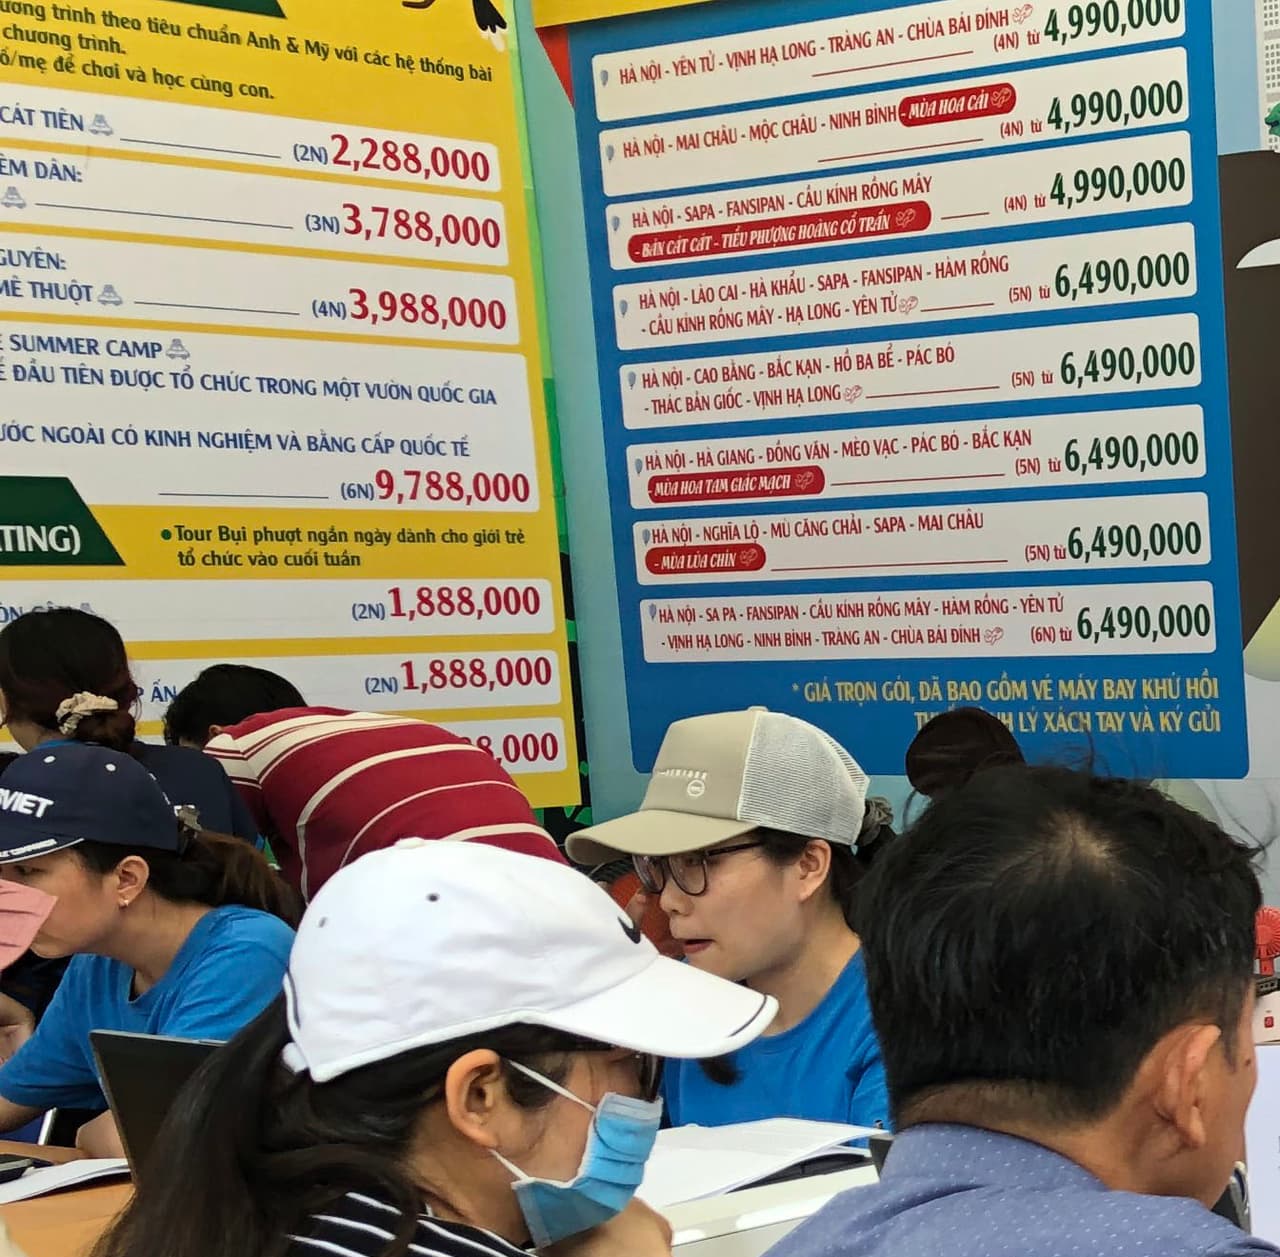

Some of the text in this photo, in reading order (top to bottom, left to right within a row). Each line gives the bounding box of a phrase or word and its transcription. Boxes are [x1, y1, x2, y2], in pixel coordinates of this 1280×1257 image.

[52, 4, 492, 82] trình theo tiêu chuẩn Anh & Mỹ với các hệ thống bài
[620, 65, 638, 84] HÀ
[640, 60, 662, 83] NỘI
[672, 53, 696, 76] YÊN
[699, 50, 715, 72] TỬ
[726, 49, 756, 71] VỊNH
[760, 46, 779, 66] HẠ
[782, 40, 816, 60] LONG
[828, 27, 871, 53] TRÀNG
[876, 28, 894, 46] AN
[907, 17, 945, 41] CHÙA
[1001, 80, 1182, 138] (4N) từ 4,990,000
[294, 134, 490, 182] (2N) 2,288,000
[1009, 250, 1190, 303] (5N) từ 6,490,000
[312, 289, 506, 329] (4N) 3,988,000
[10, 334, 162, 358] SUMMER CAMP
[341, 470, 529, 505] (6N) 9,788,000
[174, 525, 525, 547] Tour Bụi phượt ngắn ngày dành cho giới trẻ
[804, 675, 832, 702] GIÁ
[918, 677, 943, 701] ĐÃ
[946, 680, 982, 701] BAO
[986, 672, 1028, 701] GỒM
[1031, 673, 1053, 701] VÉ
[1058, 673, 1097, 700] MÁY
[1103, 679, 1136, 700] BAY
[1142, 672, 1180, 699] KHỨ
[1185, 669, 1219, 699] HỒI
[0, 786, 54, 819] VIET
